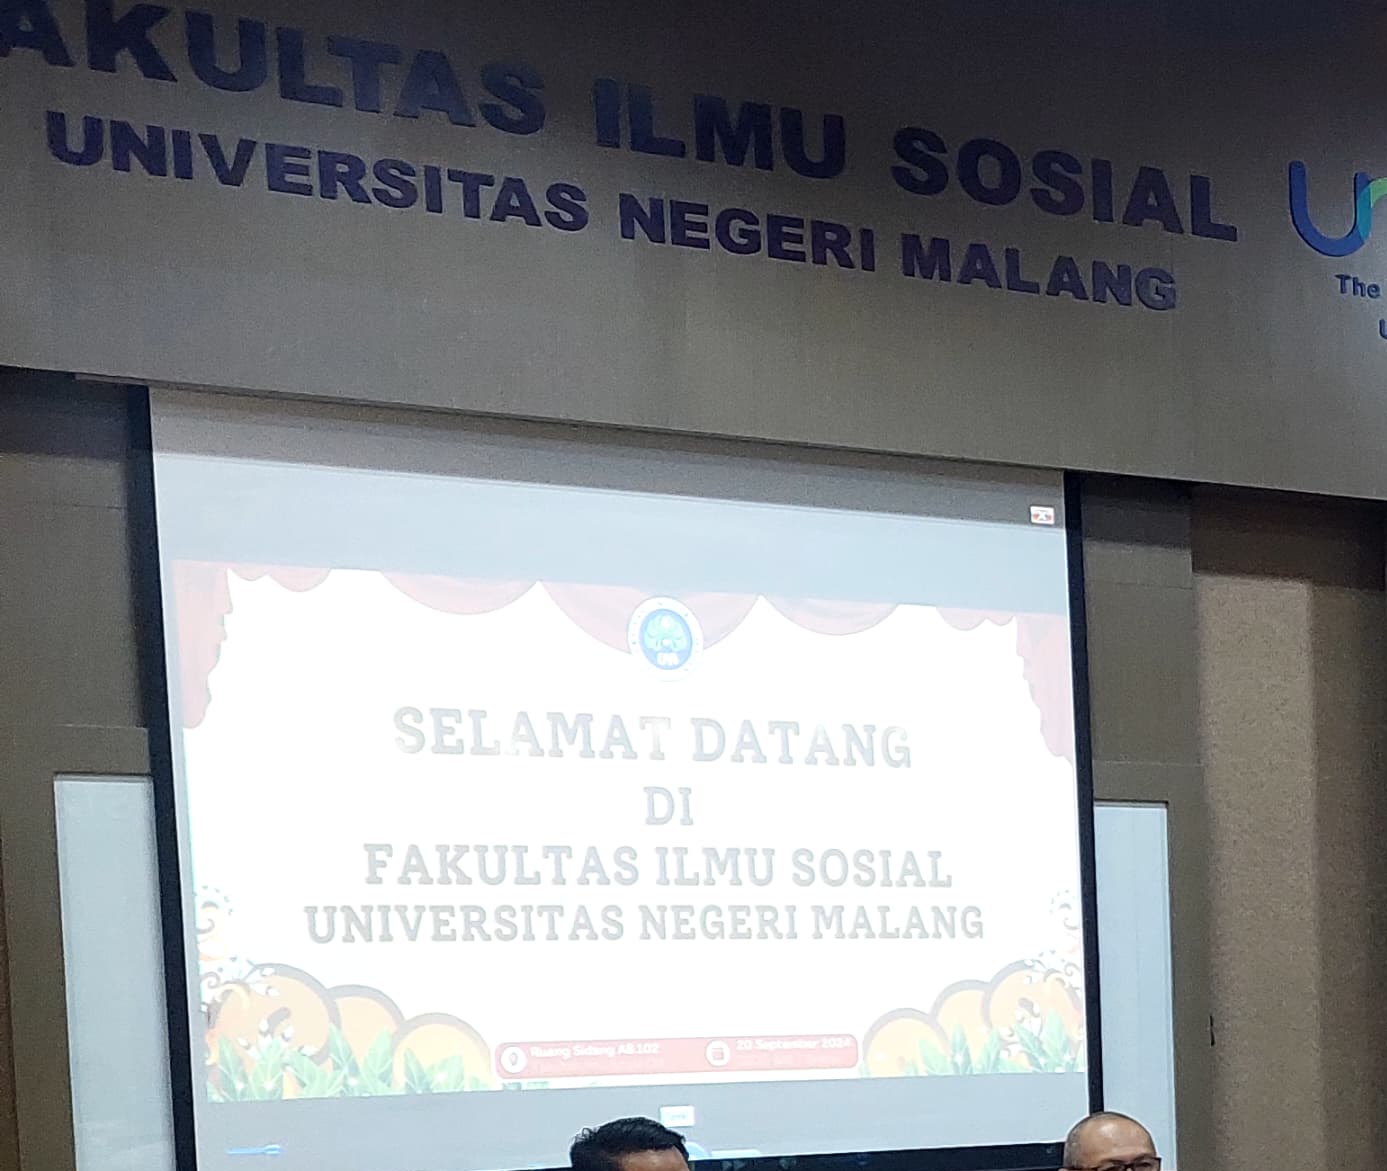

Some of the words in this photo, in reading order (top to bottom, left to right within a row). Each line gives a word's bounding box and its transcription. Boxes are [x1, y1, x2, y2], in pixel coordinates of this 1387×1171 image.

[593, 76, 845, 180] ILMU
[891, 126, 1238, 242] SOSIAL
[46, 109, 590, 232] UNIVERSITAS
[618, 192, 876, 272] NEGERI
[901, 233, 1177, 312] MALANG
[1335, 273, 1382, 299] The
[393, 707, 672, 761] SELAMAT
[690, 717, 912, 768] DATANG
[643, 786, 694, 826] DI
[363, 843, 639, 886] FAKULTAS
[655, 845, 776, 887] ILMU
[791, 848, 953, 889] SOSIAL
[302, 904, 625, 944] UNIVERSITAS
[638, 904, 799, 941] NEGERI
[810, 904, 984, 941] MALANG
[754, 1039, 819, 1051] September
